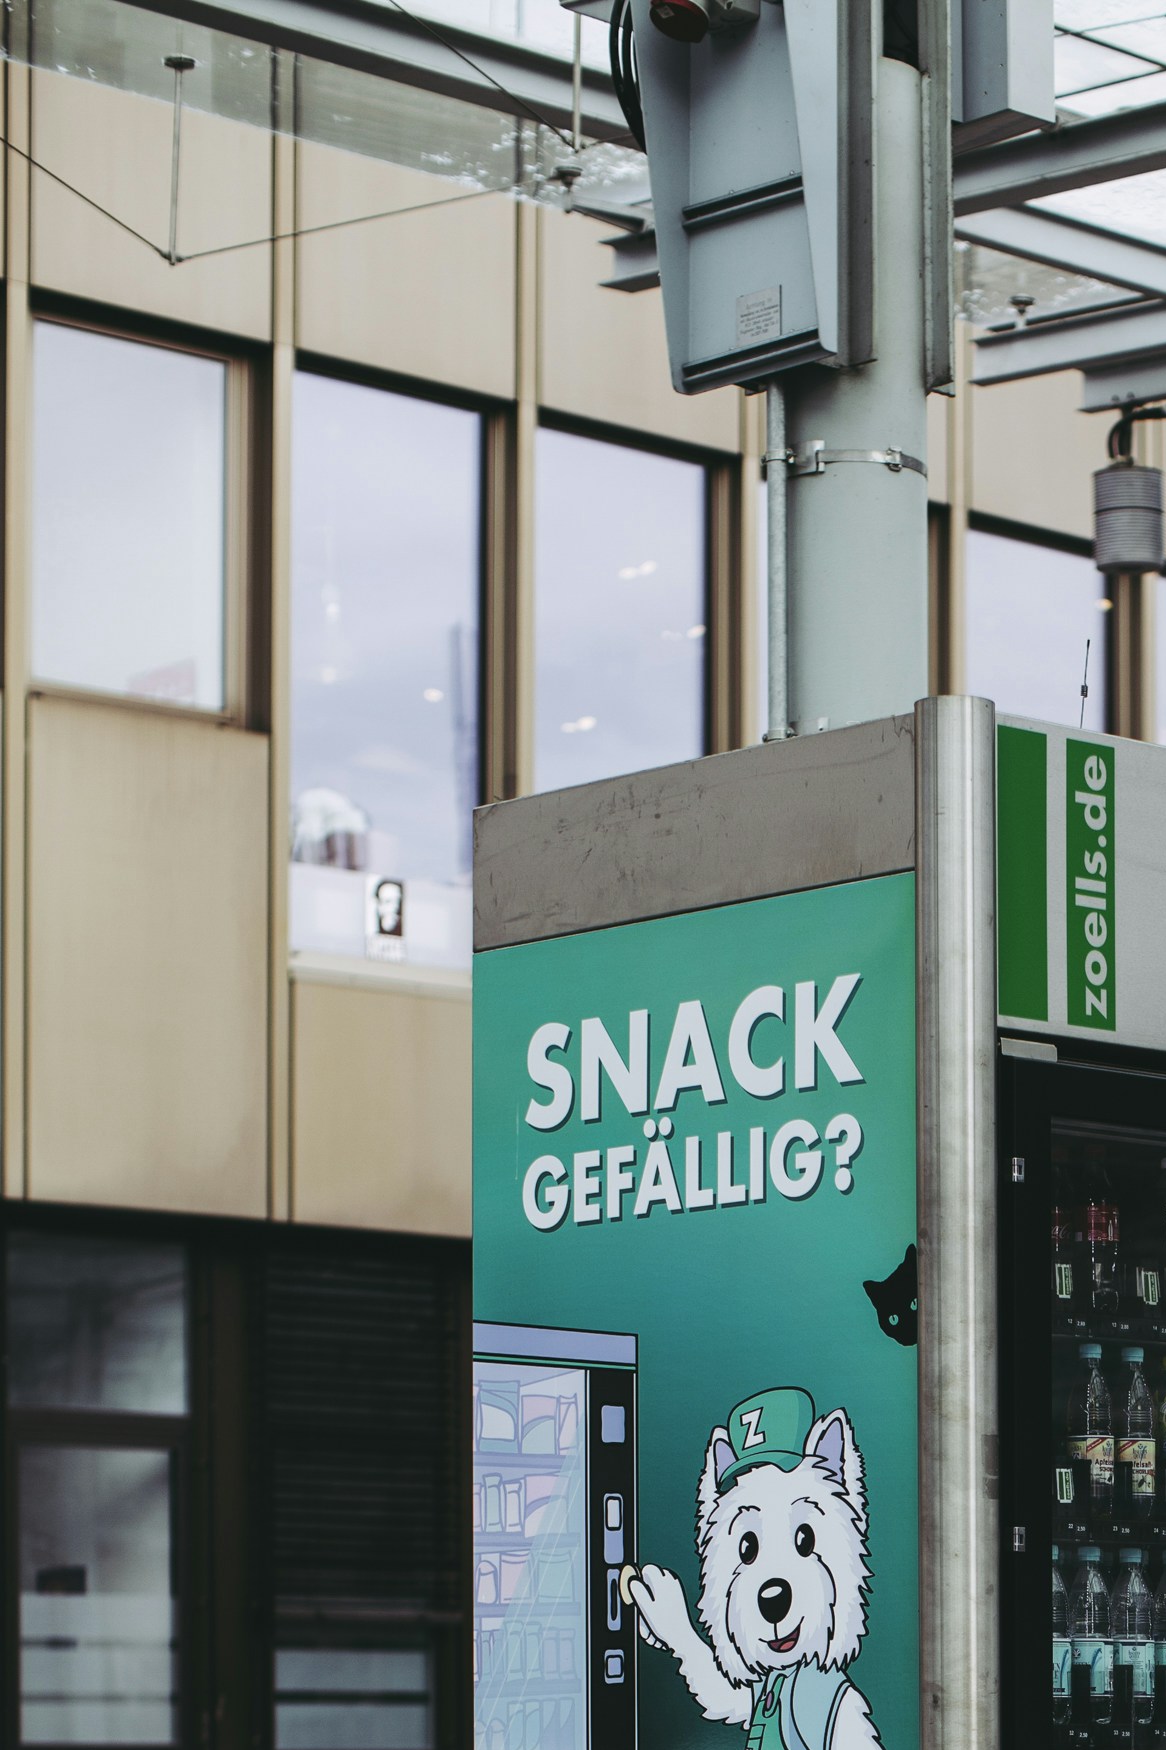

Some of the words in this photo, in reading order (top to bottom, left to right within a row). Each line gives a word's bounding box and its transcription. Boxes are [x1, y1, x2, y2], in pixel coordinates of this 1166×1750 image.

[1074, 753, 1108, 1019] zoells.de
[525, 972, 866, 1130] SNACK
[522, 1112, 865, 1232] GEFÄLLIG?
[740, 1406, 767, 1449] Z
